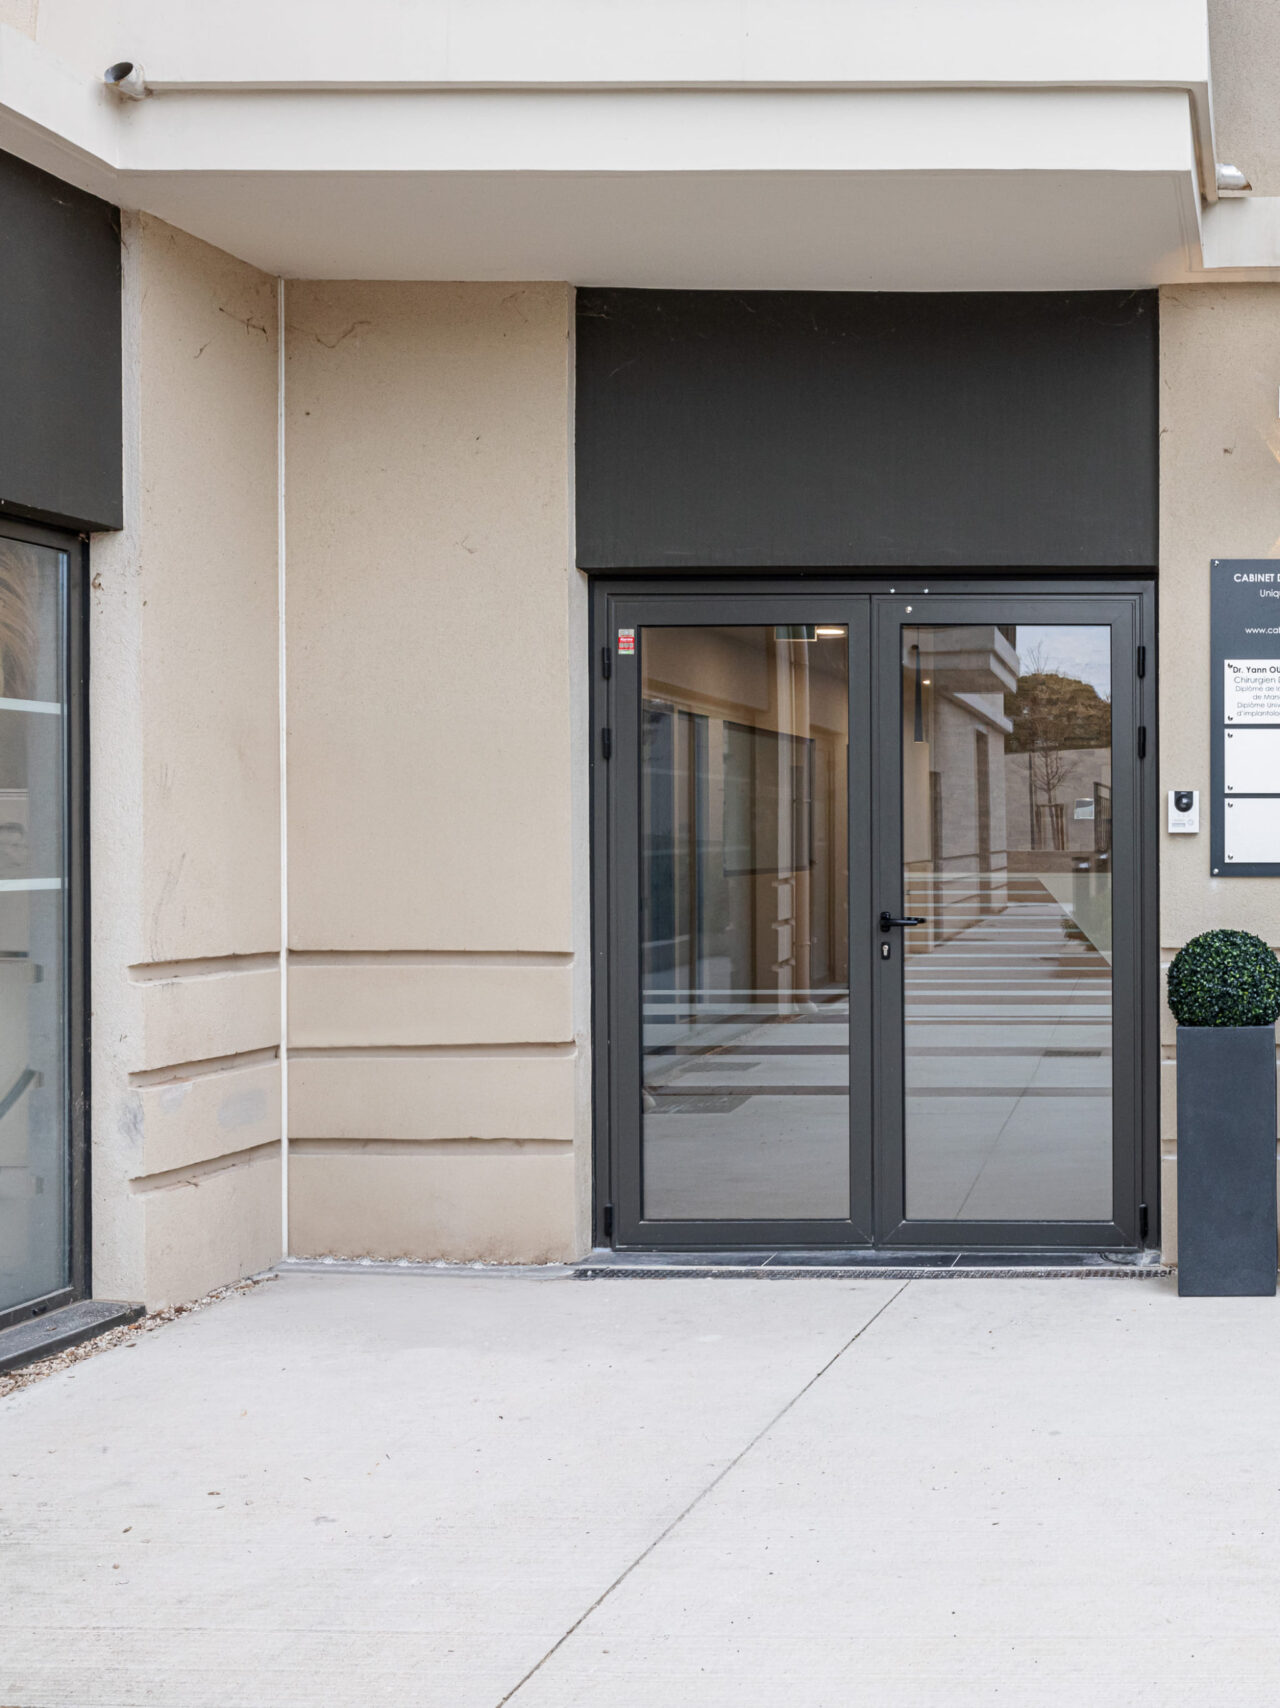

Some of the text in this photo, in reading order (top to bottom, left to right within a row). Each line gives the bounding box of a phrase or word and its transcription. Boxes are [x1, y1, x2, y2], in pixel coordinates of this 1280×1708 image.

[1233, 573, 1274, 583] CABINET
[1232, 666, 1244, 674] Dr.
[1234, 676, 1276, 685] Chirurgien
